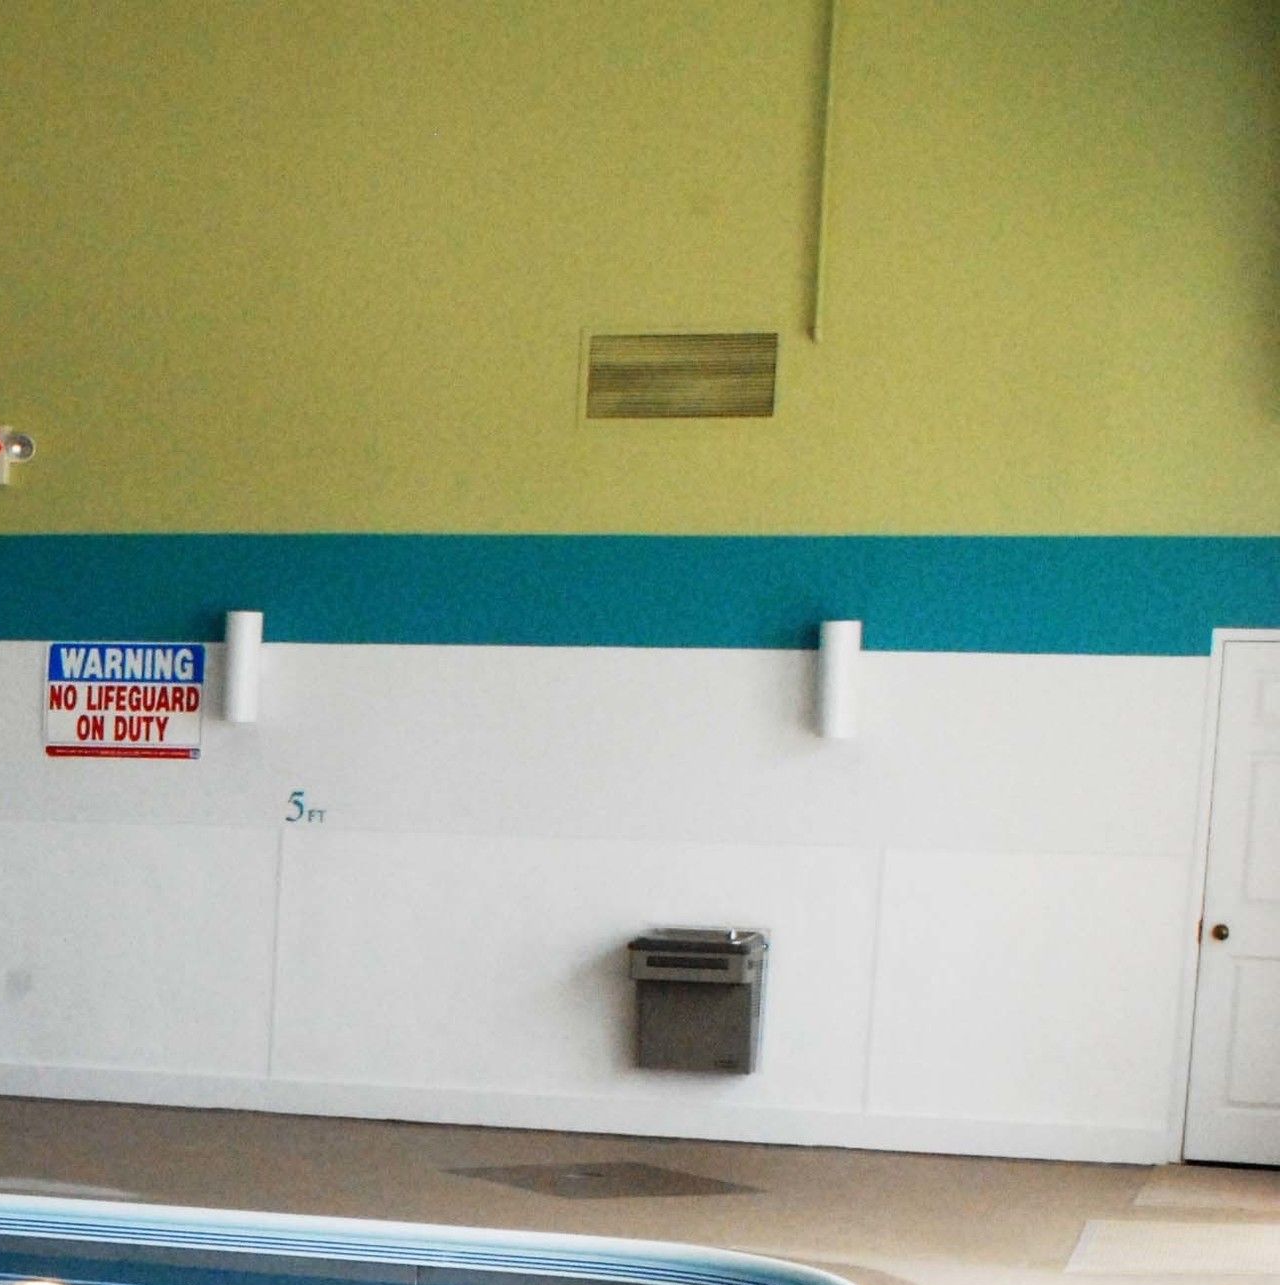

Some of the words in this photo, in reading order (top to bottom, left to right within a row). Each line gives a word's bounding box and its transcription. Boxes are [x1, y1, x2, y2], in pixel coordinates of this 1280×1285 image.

[60, 648, 194, 680] WARNING
[49, 684, 78, 710] NO
[86, 685, 200, 713] LIFEGUARD
[76, 714, 104, 741] ON
[114, 715, 170, 742] DUTY
